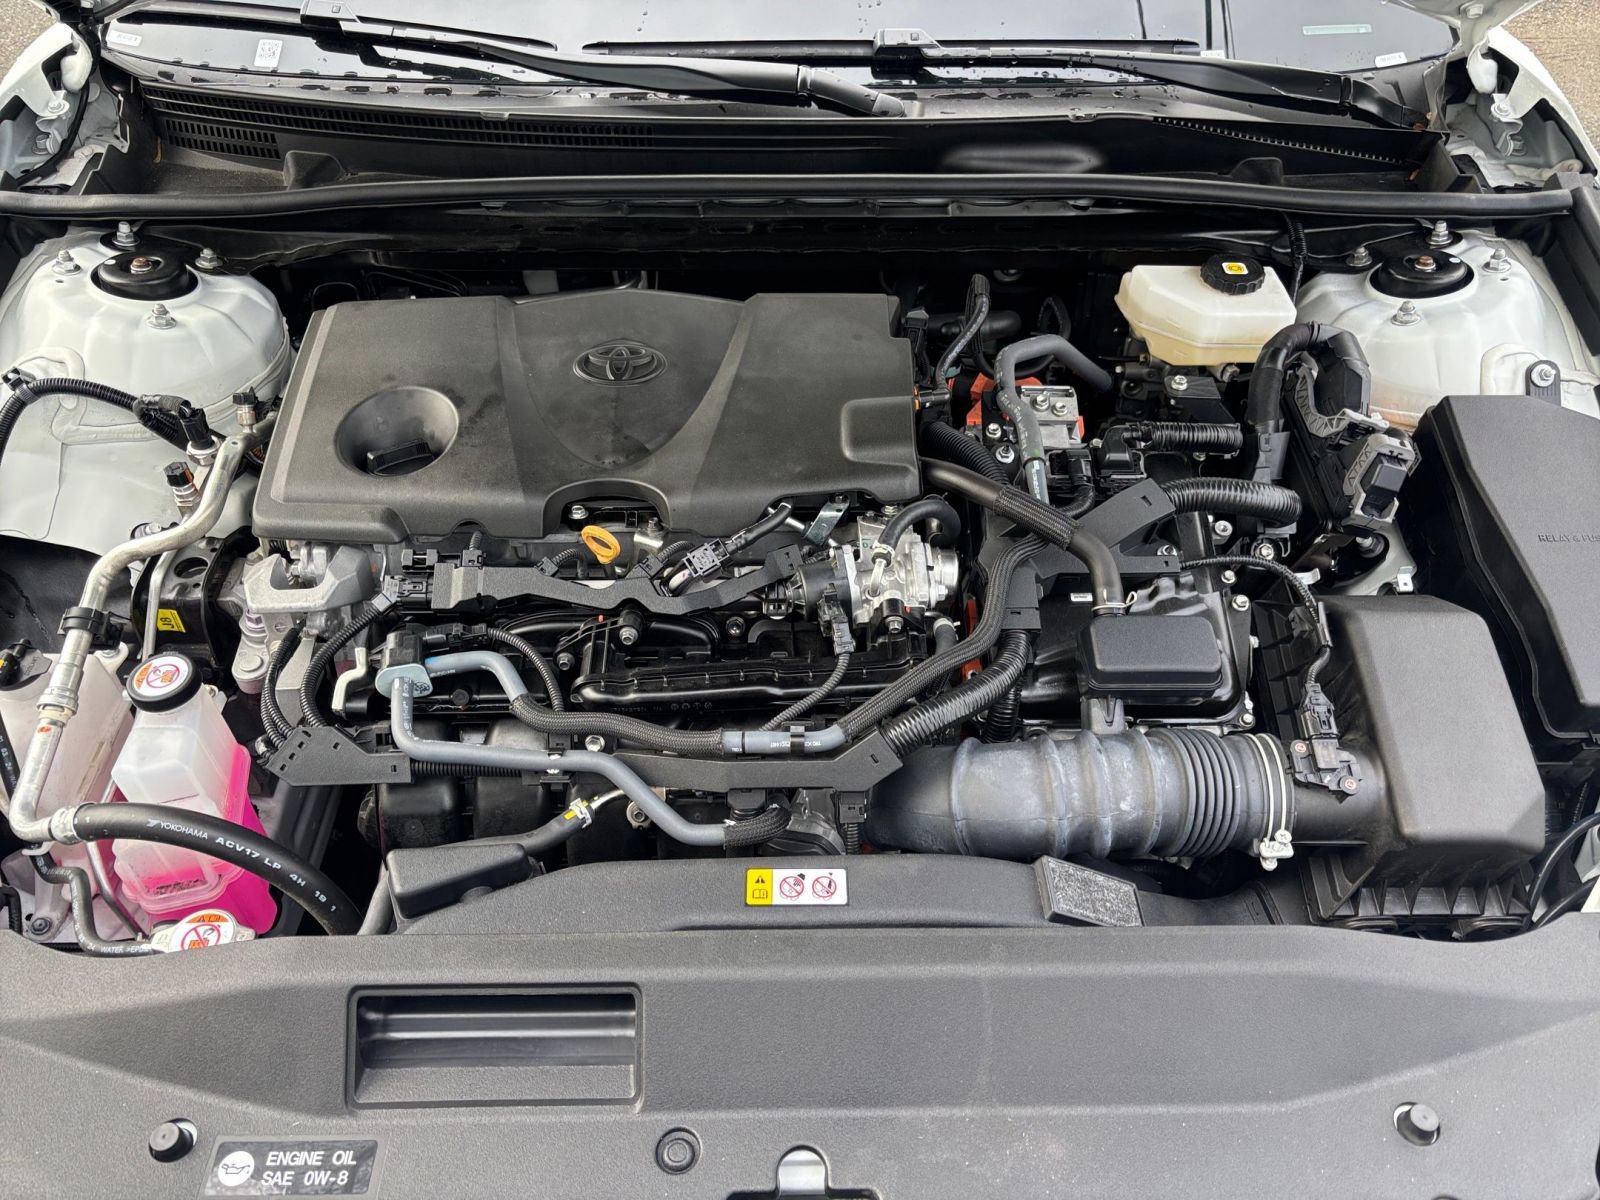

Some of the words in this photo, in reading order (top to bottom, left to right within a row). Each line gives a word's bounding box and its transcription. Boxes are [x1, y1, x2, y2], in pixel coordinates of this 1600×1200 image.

[1537, 534, 1570, 542] RELAY
[160, 820, 208, 839] YOKOHAMA
[215, 836, 260, 858] ACV17
[263, 857, 282, 870] LP
[289, 873, 306, 887] 4H
[265, 1151, 325, 1166] ENGINE
[332, 1150, 357, 1166] OIL
[261, 1171, 295, 1186] SAE
[303, 1170, 349, 1186] 0W-8
